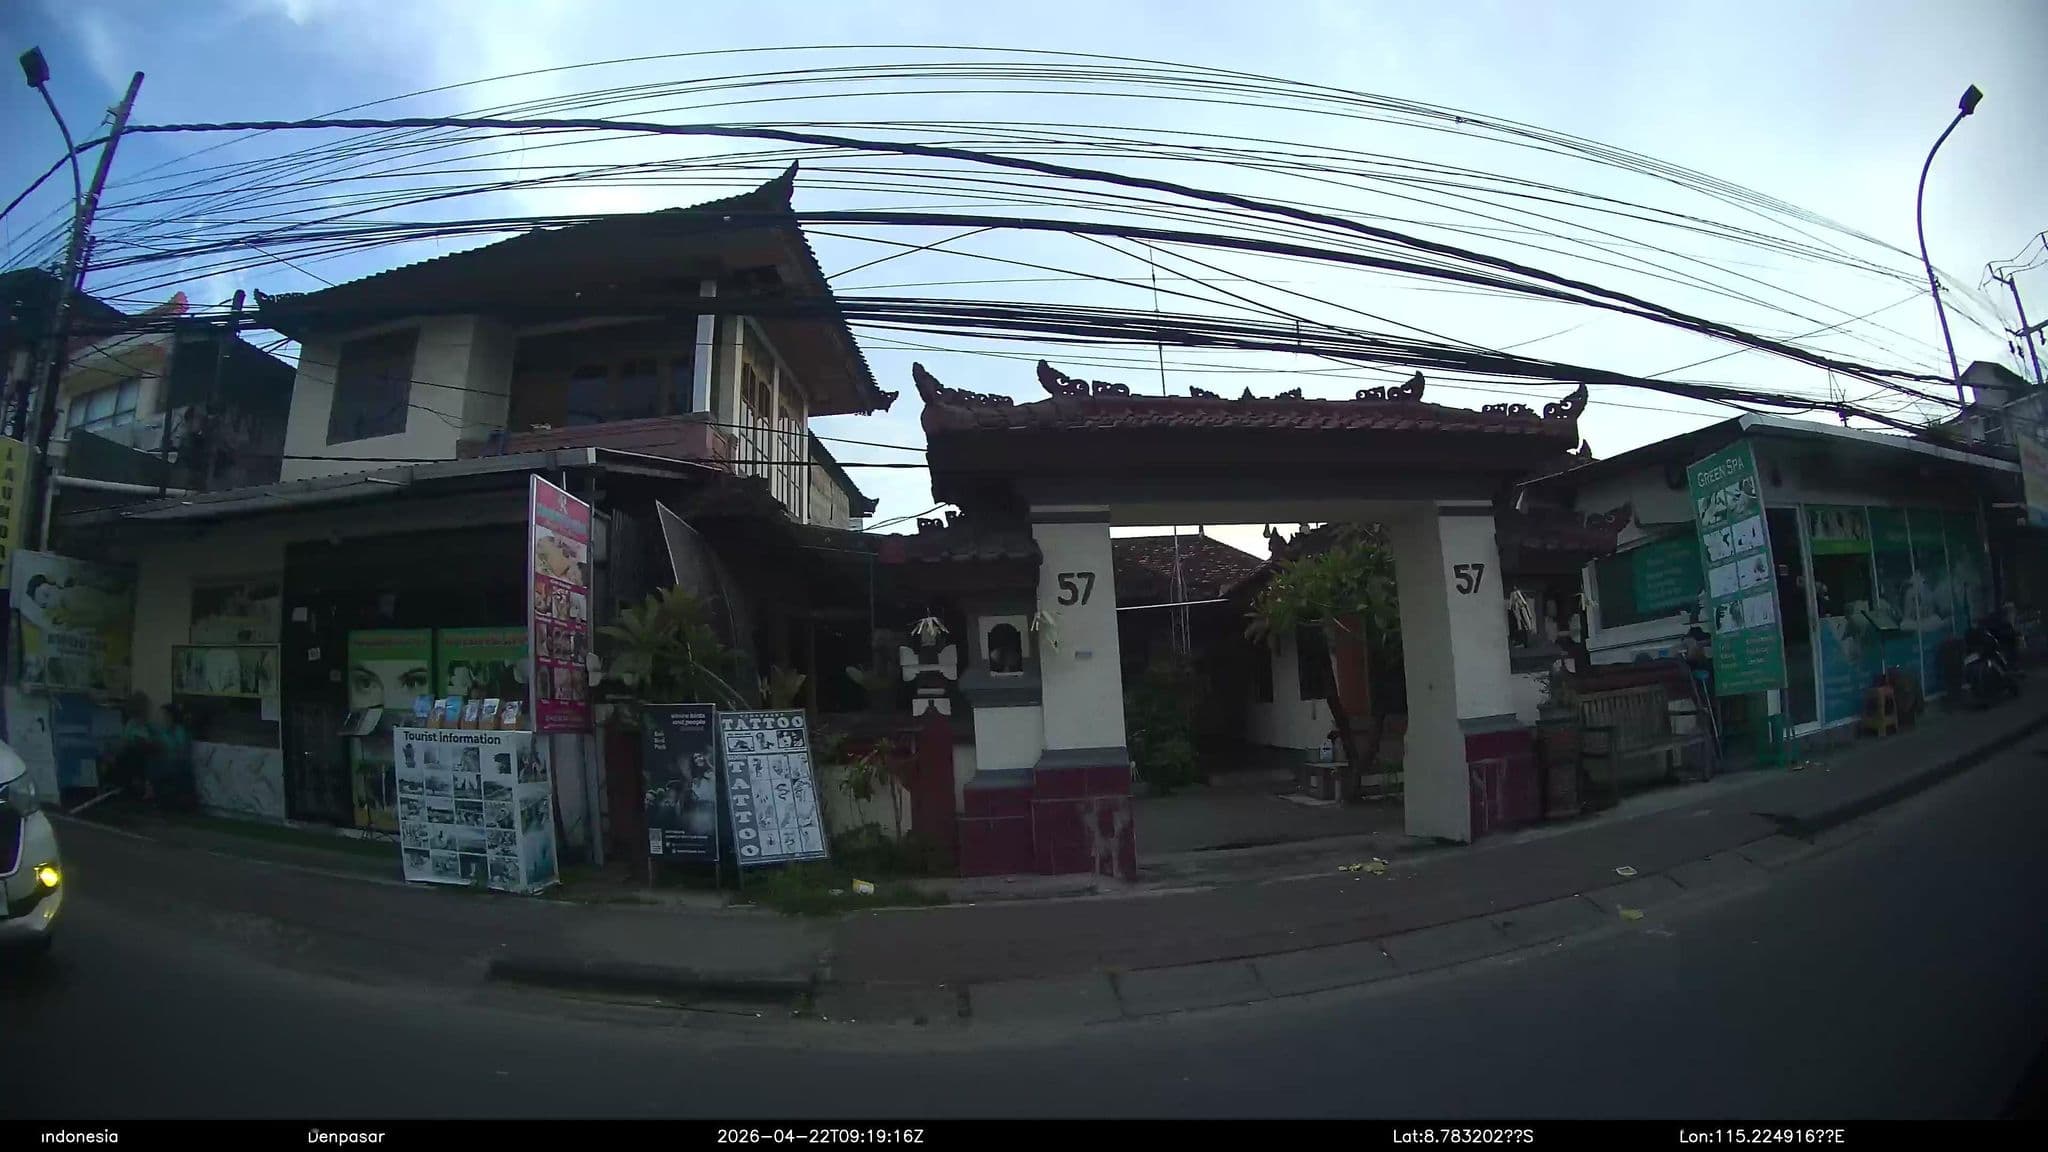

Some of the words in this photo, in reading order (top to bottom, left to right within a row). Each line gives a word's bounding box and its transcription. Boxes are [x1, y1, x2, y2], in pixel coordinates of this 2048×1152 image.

[1057, 571, 1096, 606] 57
[1453, 563, 1485, 595] 57
[403, 730, 438, 742] Tourist
[721, 716, 804, 730] TATTOO
[728, 761, 760, 857] TATTOO
